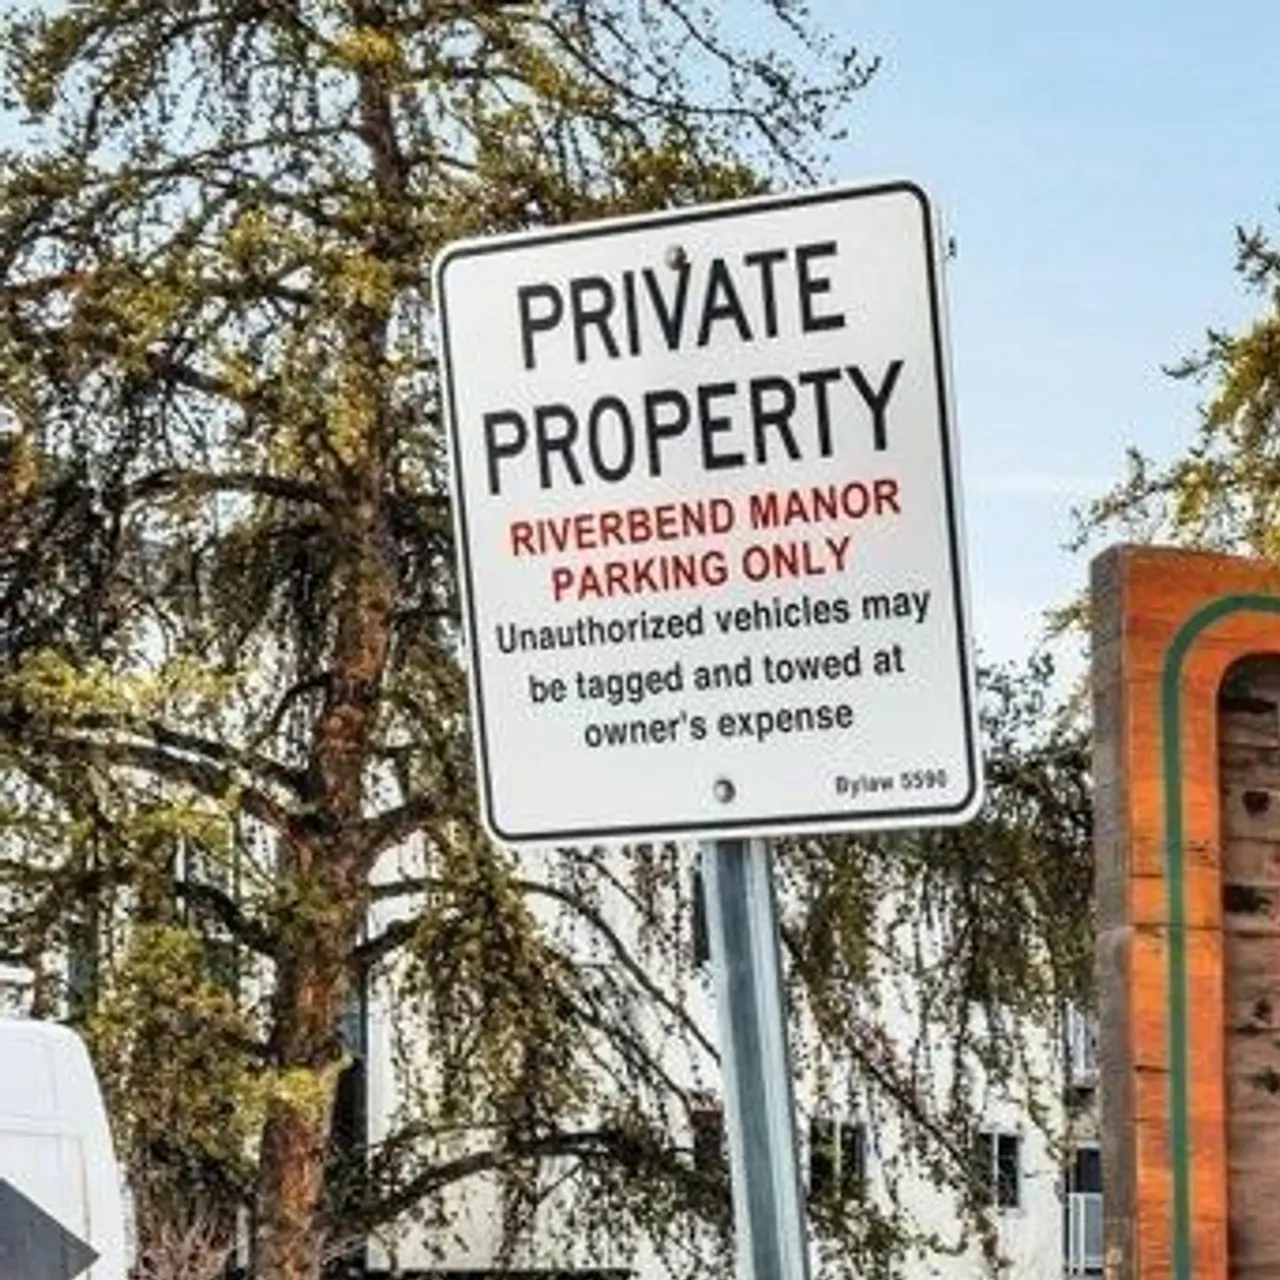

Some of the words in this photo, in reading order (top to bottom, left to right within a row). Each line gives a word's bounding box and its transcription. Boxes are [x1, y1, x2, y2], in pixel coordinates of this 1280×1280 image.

[517, 240, 846, 369] PRIVATE
[482, 360, 903, 495] PROPERTY
[511, 499, 735, 556] RIVERBEND
[750, 479, 901, 530] MANOR
[552, 551, 728, 602] PARKING
[742, 536, 852, 581] ONLY
[496, 607, 703, 654] Unauthorized
[715, 593, 850, 634] vehicles
[862, 590, 931, 623] may
[529, 676, 567, 704] be
[577, 663, 684, 705] tagged
[694, 657, 752, 690] and
[764, 645, 861, 684] towed
[873, 643, 906, 675] at
[584, 714, 707, 748] owner's
[718, 704, 854, 742] expense
